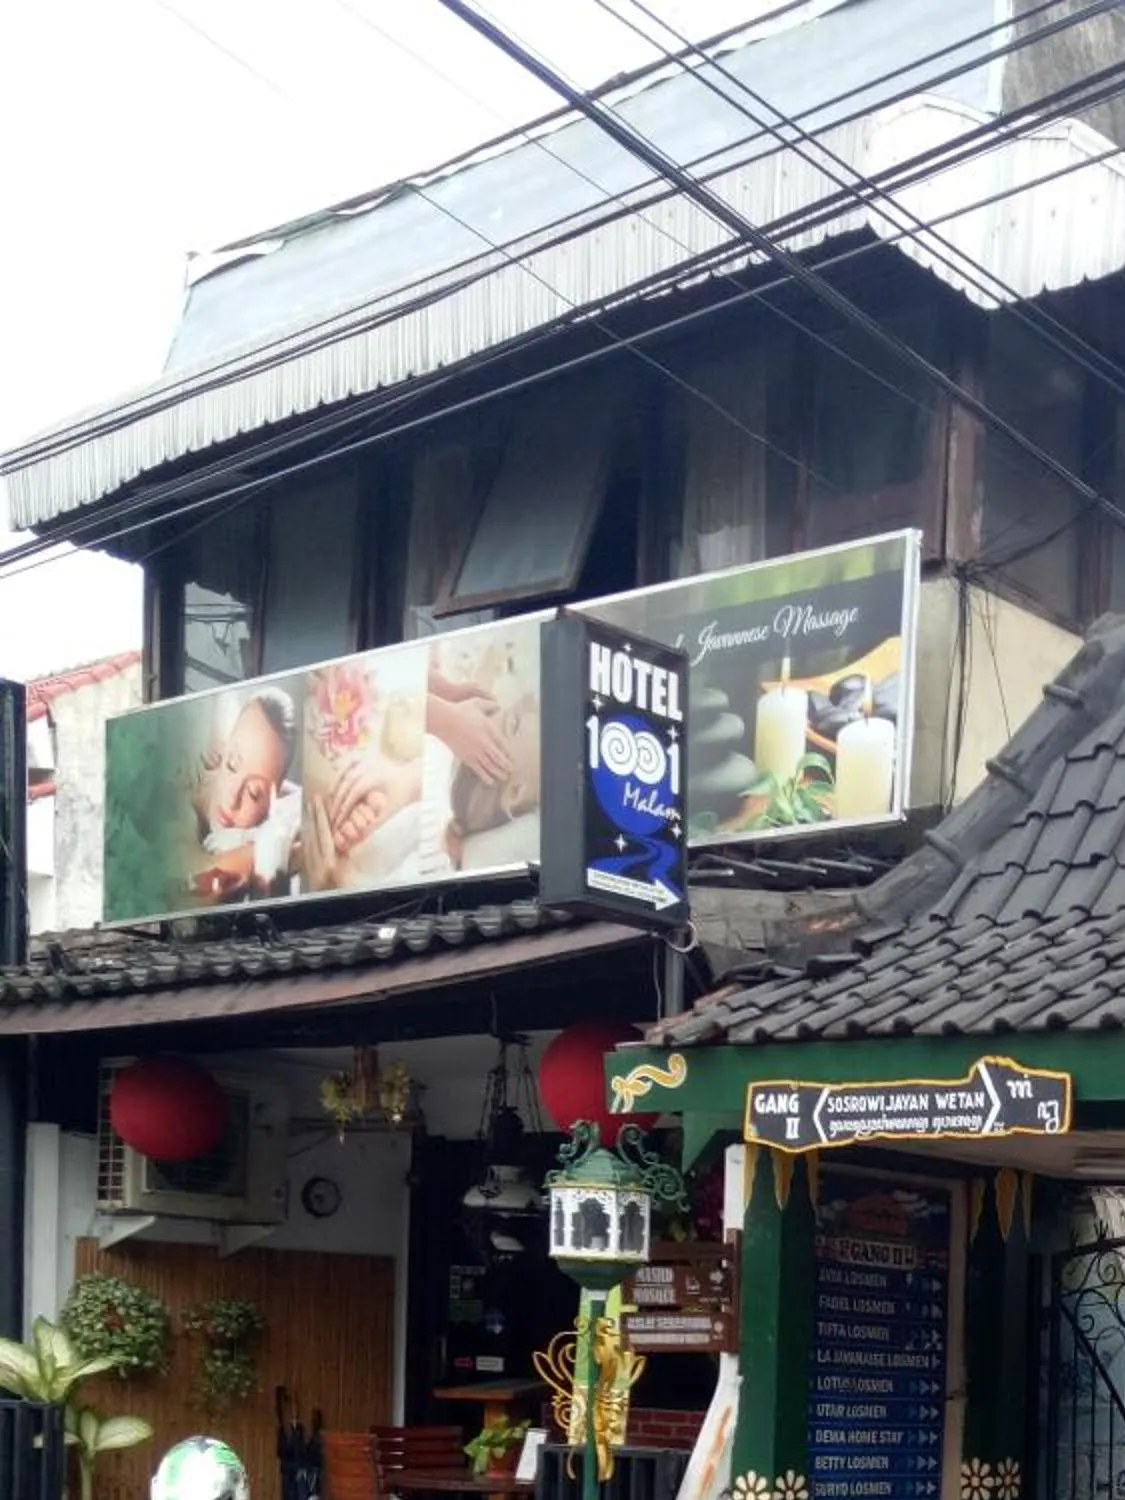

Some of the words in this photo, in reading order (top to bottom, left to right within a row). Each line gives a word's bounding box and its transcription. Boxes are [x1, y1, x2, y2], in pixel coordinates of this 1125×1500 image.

[773, 604, 860, 639] Massage
[589, 641, 683, 722] HOTEL
[586, 714, 681, 796] 1001
[623, 781, 682, 822] Malam
[755, 1093, 799, 1115] GANG
[827, 1093, 929, 1114] SOSROWIJAYAN
[935, 1091, 985, 1111] WETAN
